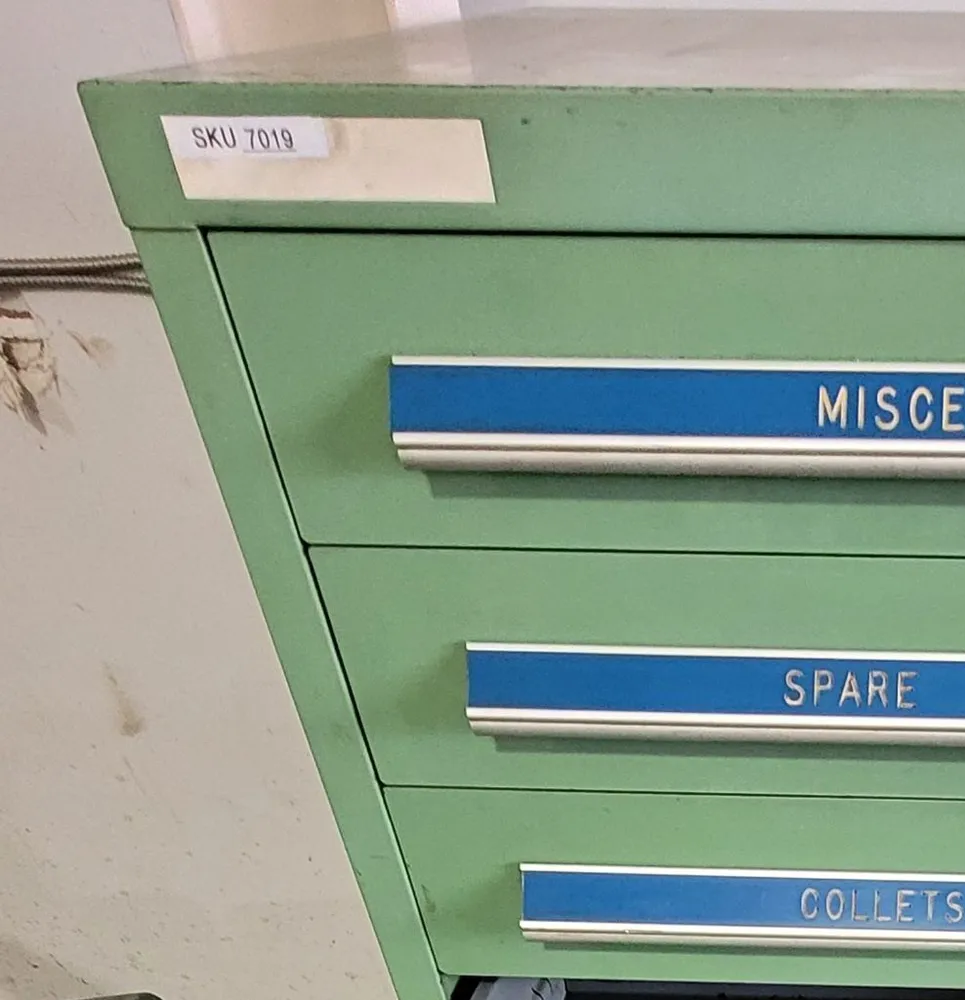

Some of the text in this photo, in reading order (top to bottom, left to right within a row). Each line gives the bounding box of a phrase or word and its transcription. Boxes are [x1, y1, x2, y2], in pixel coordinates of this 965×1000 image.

[191, 126, 296, 151] SKU 7019
[783, 668, 918, 709] SPARE
[800, 887, 965, 924] COLLETS
